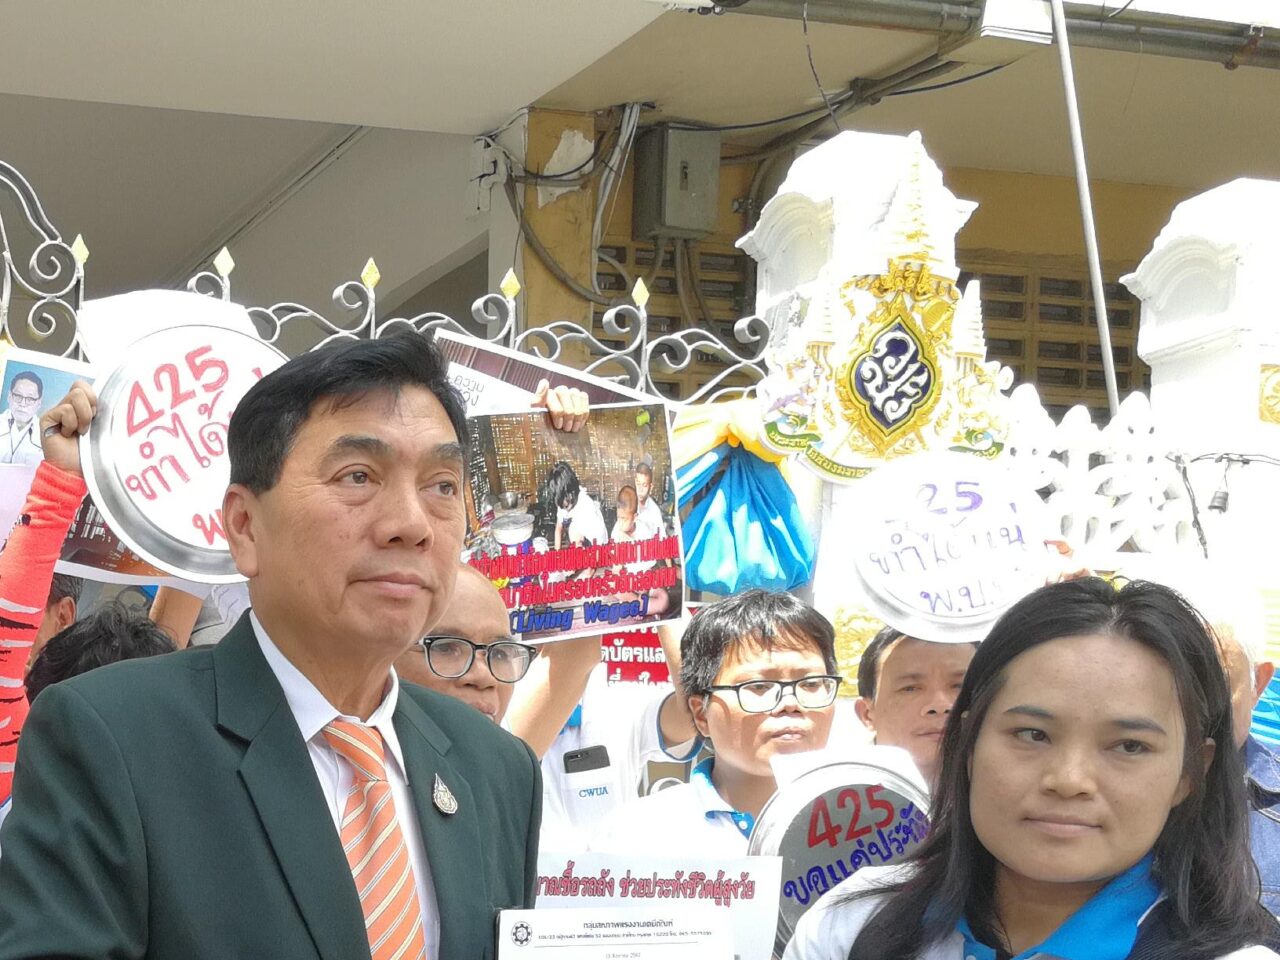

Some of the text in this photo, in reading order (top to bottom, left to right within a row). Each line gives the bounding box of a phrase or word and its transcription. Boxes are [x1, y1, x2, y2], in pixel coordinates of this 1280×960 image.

[126, 345, 230, 438] 425
[578, 786, 609, 799] CWUA
[807, 783, 895, 849] 425
